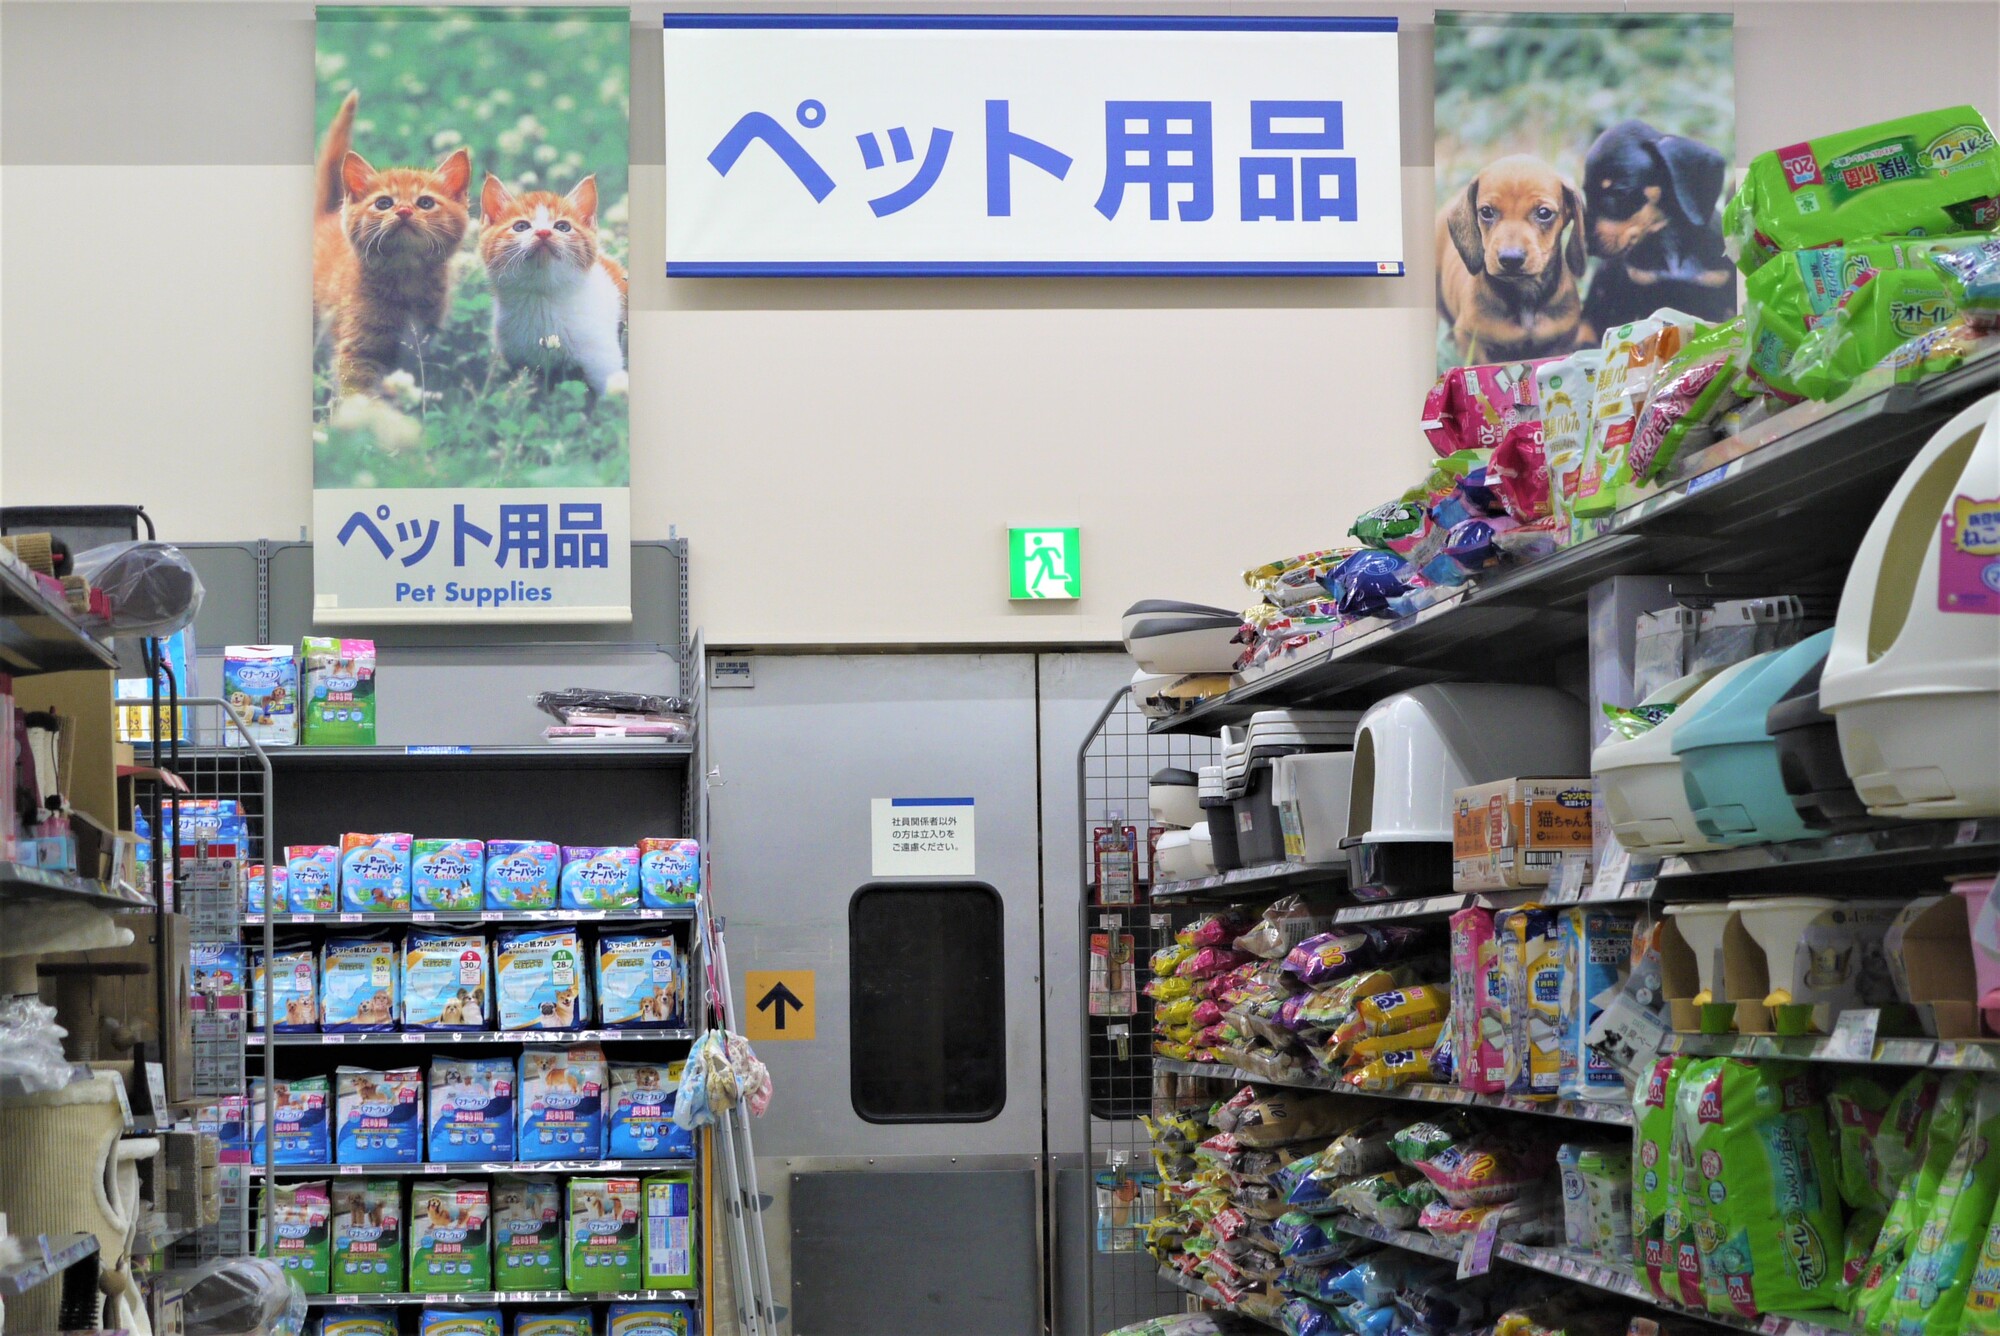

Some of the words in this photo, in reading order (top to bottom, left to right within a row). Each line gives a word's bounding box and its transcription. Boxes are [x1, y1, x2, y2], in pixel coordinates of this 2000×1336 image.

[1932, 132, 1995, 161] デオトイレ
[708, 99, 1358, 222] ペット用品
[337, 503, 608, 569] ペット用品
[1963, 525, 2000, 547] ねこ
[396, 582, 435, 602] Pet
[445, 580, 552, 607] Supplies
[892, 816, 957, 826] 社員関係者以外
[892, 829, 955, 839] の方は立入りを
[893, 842, 959, 852] ご遠慮ください。
[352, 863, 403, 874] マナーパッド
[423, 865, 471, 874] マナーパッド
[650, 862, 691, 870] マナーパッド
[497, 868, 544, 877] マナーパッド
[580, 870, 627, 879] マナーパッド
[467, 952, 473, 960] S
